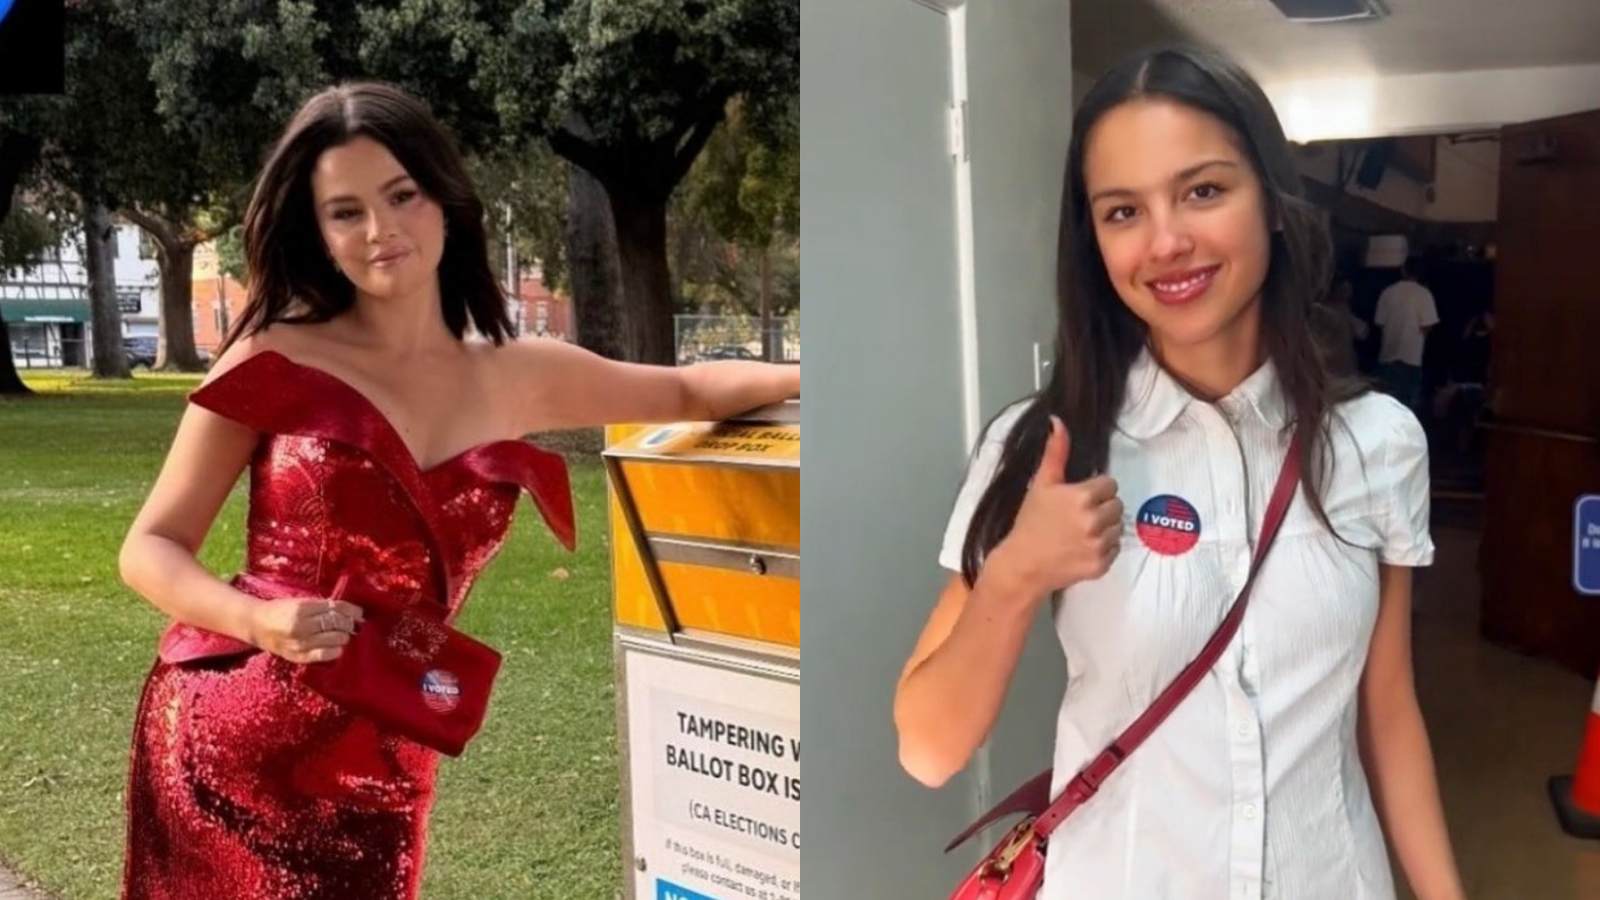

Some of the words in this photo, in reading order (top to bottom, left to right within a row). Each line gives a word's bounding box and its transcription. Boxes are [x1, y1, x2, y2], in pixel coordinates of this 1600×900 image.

[1143, 511, 1149, 523] I
[1151, 513, 1195, 532] VOTED
[428, 684, 460, 695] VOTED
[677, 711, 785, 758] TAMPERING
[666, 744, 734, 781] BALLOT
[738, 763, 779, 796] BOX
[784, 775, 800, 801] IS
[689, 799, 711, 821] (CA
[714, 809, 788, 845] ELECTIONS
